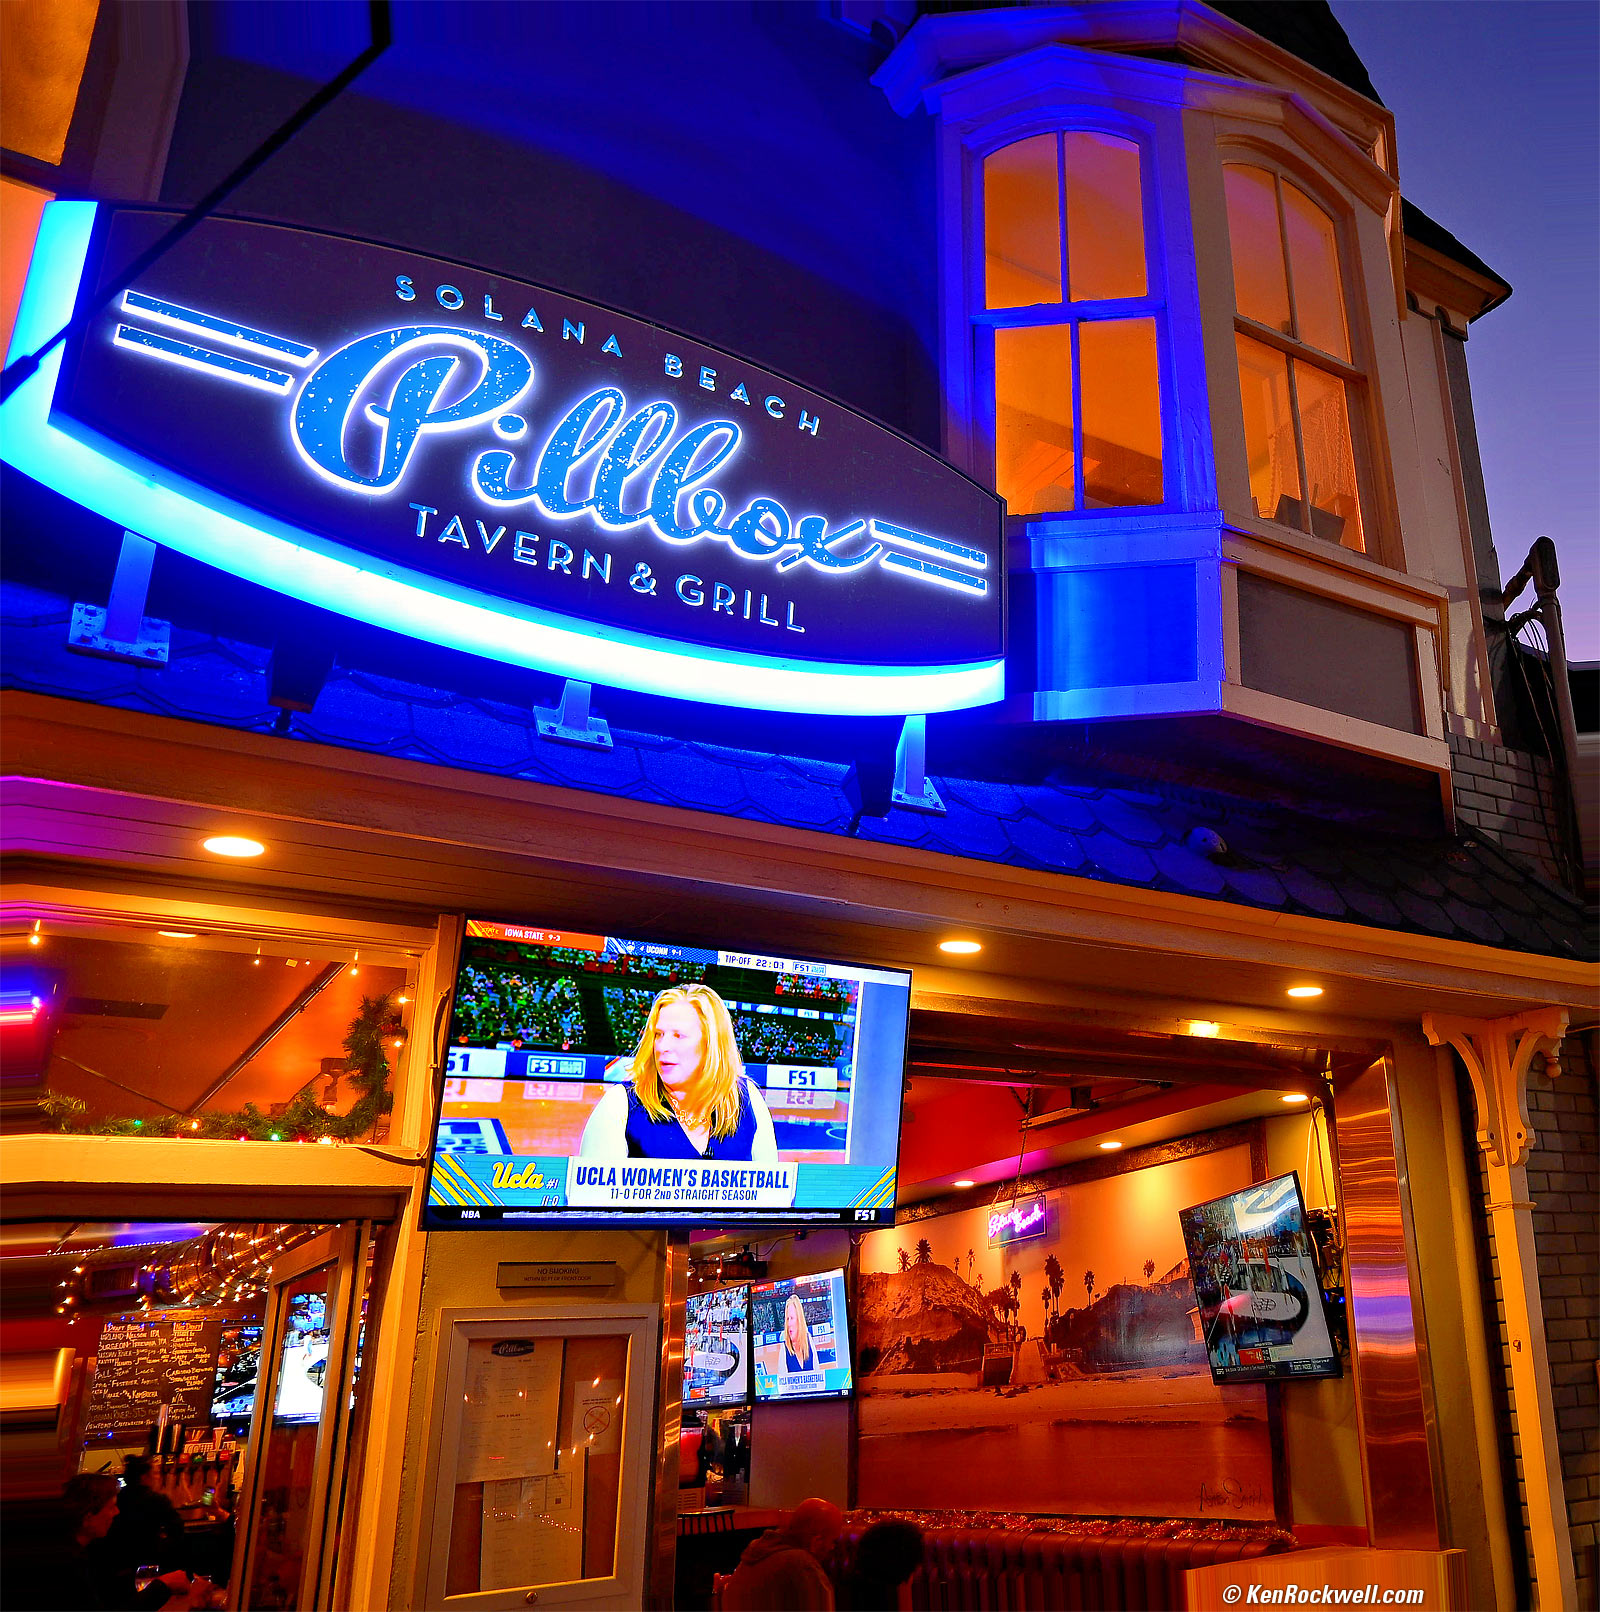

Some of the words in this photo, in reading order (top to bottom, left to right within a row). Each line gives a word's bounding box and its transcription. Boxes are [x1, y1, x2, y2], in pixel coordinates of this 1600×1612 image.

[395, 275, 623, 358] SOLANA
[664, 352, 820, 436] BEACH
[290, 324, 882, 574] Pillbox
[409, 502, 612, 584] TAVERN
[628, 562, 657, 596] &
[675, 574, 806, 633] GRILL
[505, 928, 523, 938] IOWA
[524, 931, 544, 941] STATE
[646, 945, 668, 956] UCONN
[756, 959, 784, 970] 22:03
[794, 964, 810, 973] FS1
[531, 1059, 556, 1073] FS1
[788, 1070, 816, 1086] FS1
[492, 1161, 544, 1190] Ucla
[576, 1166, 616, 1186] UCLA
[622, 1167, 697, 1188] WOMEN'S
[701, 1169, 789, 1189] BASKETBALL
[611, 1188, 629, 1200] 11-0
[633, 1189, 651, 1200] FOR
[654, 1189, 671, 1200] 2ND
[673, 1189, 719, 1201] STRAIGHT
[722, 1189, 758, 1201] SEASON
[461, 1210, 481, 1219] NBA
[855, 1210, 876, 1221] FS1
[537, 1267, 548, 1275] NO
